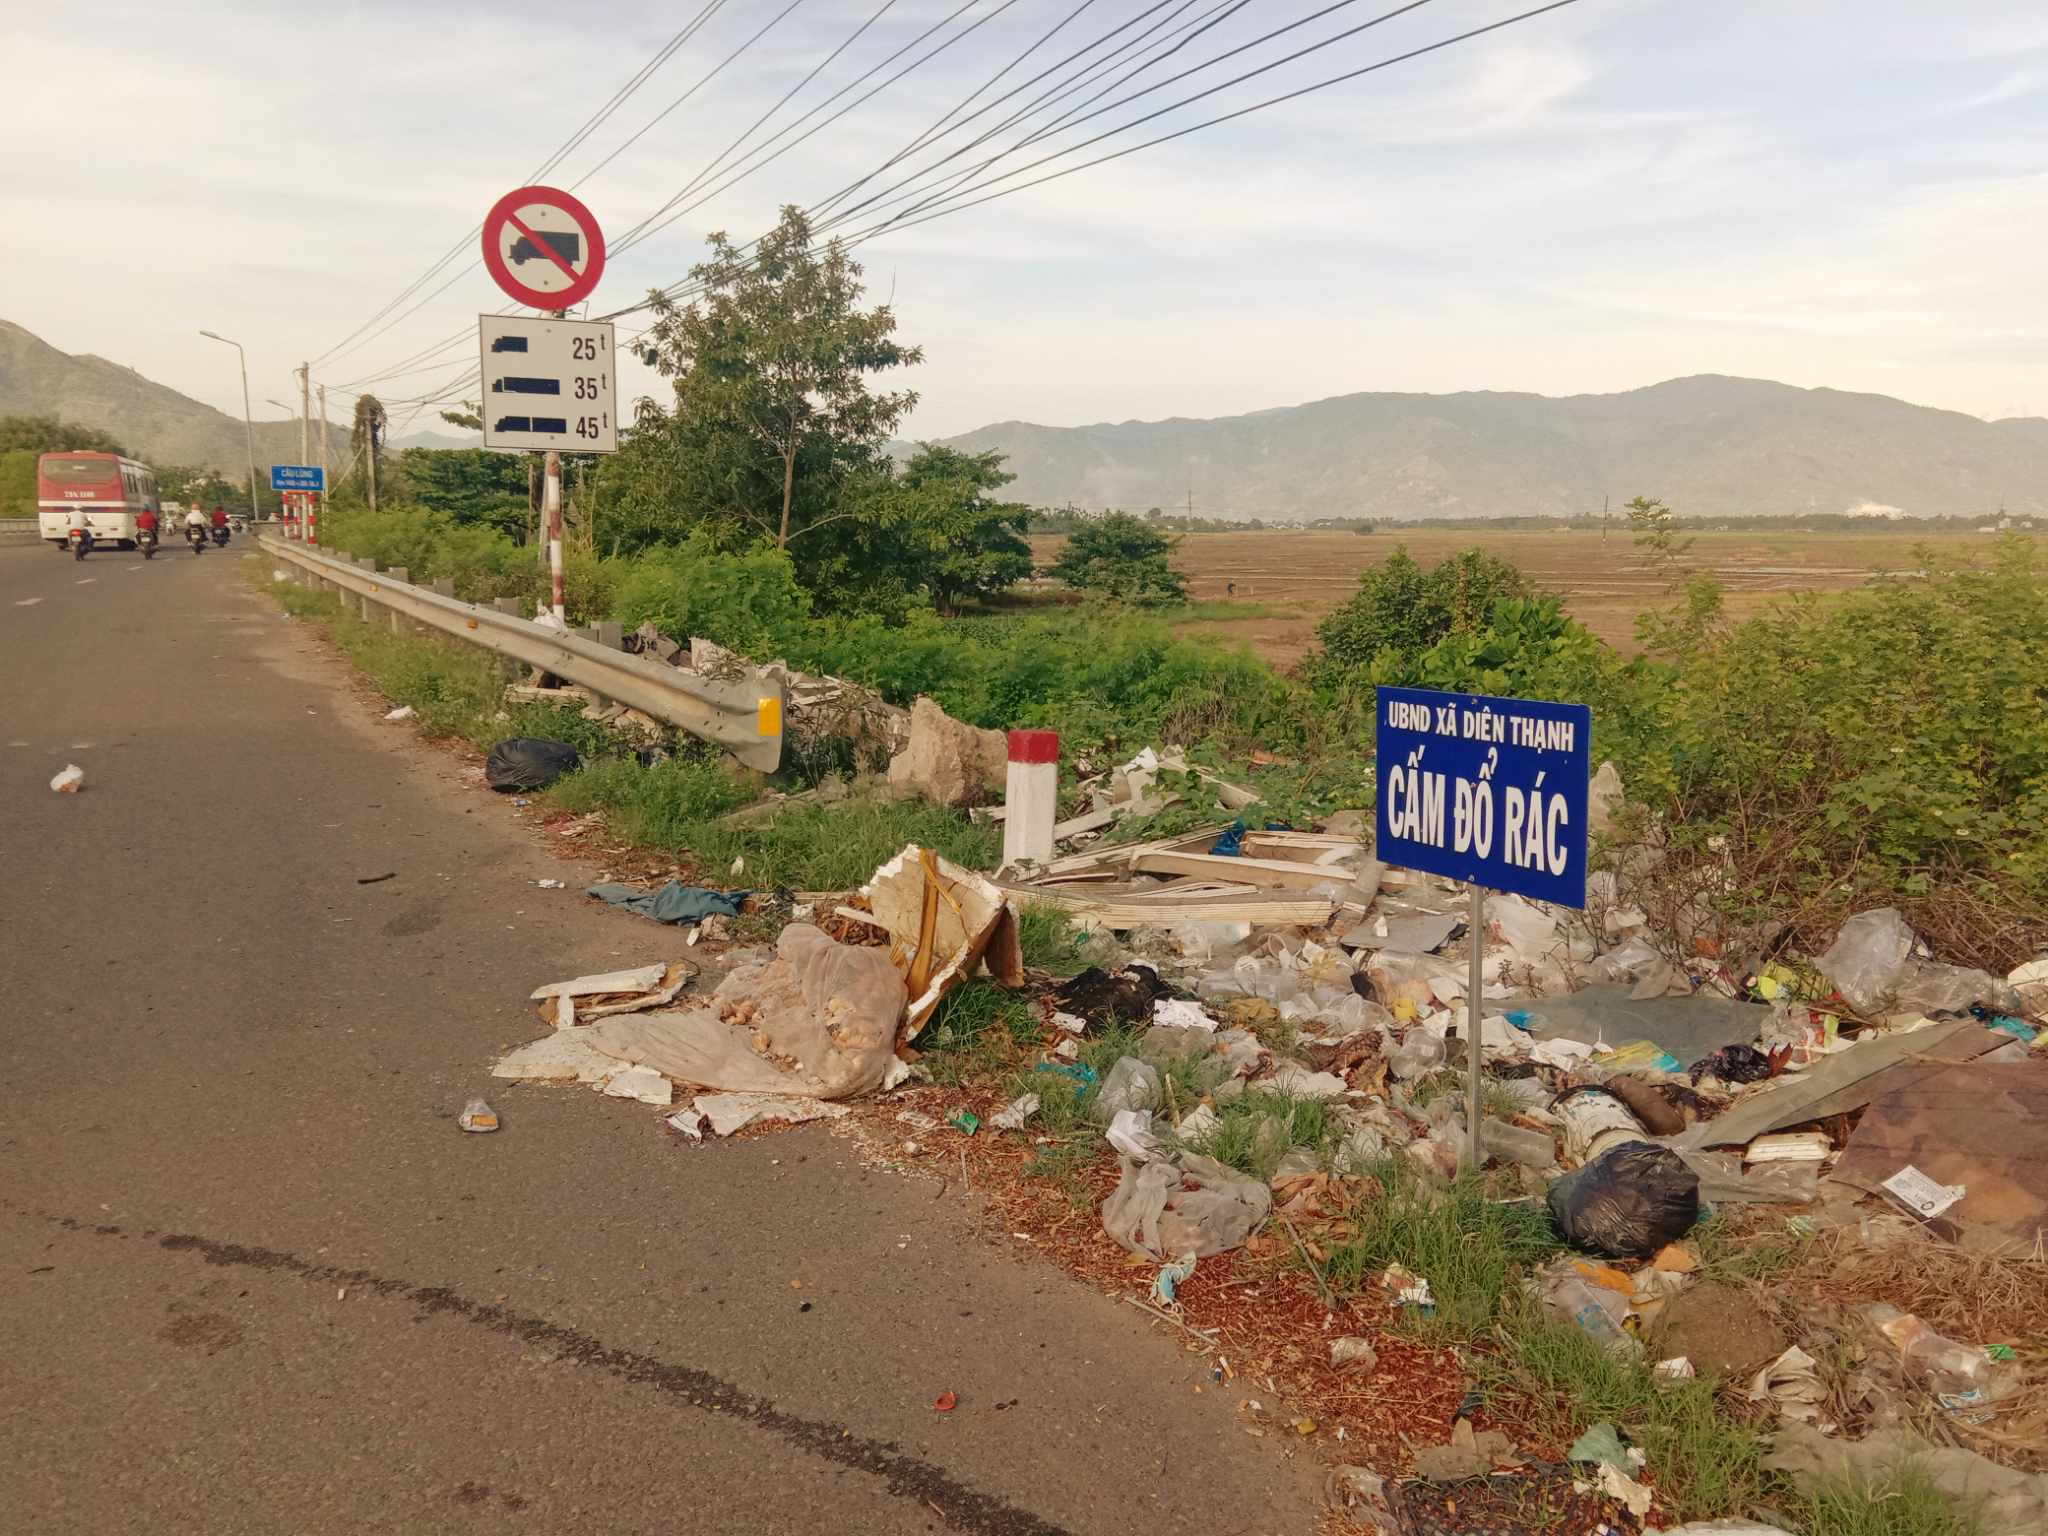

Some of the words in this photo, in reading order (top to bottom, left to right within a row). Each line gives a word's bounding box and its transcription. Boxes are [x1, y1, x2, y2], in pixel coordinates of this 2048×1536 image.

[1388, 701, 1431, 733] UBND
[1435, 703, 1458, 737] XÃ
[1463, 706, 1505, 743] DIÊN
[1510, 716, 1575, 755] THẠNH
[1388, 744, 1446, 848] CẤM
[1453, 746, 1498, 860] ĐỔ
[1504, 771, 1569, 877] RÁC
